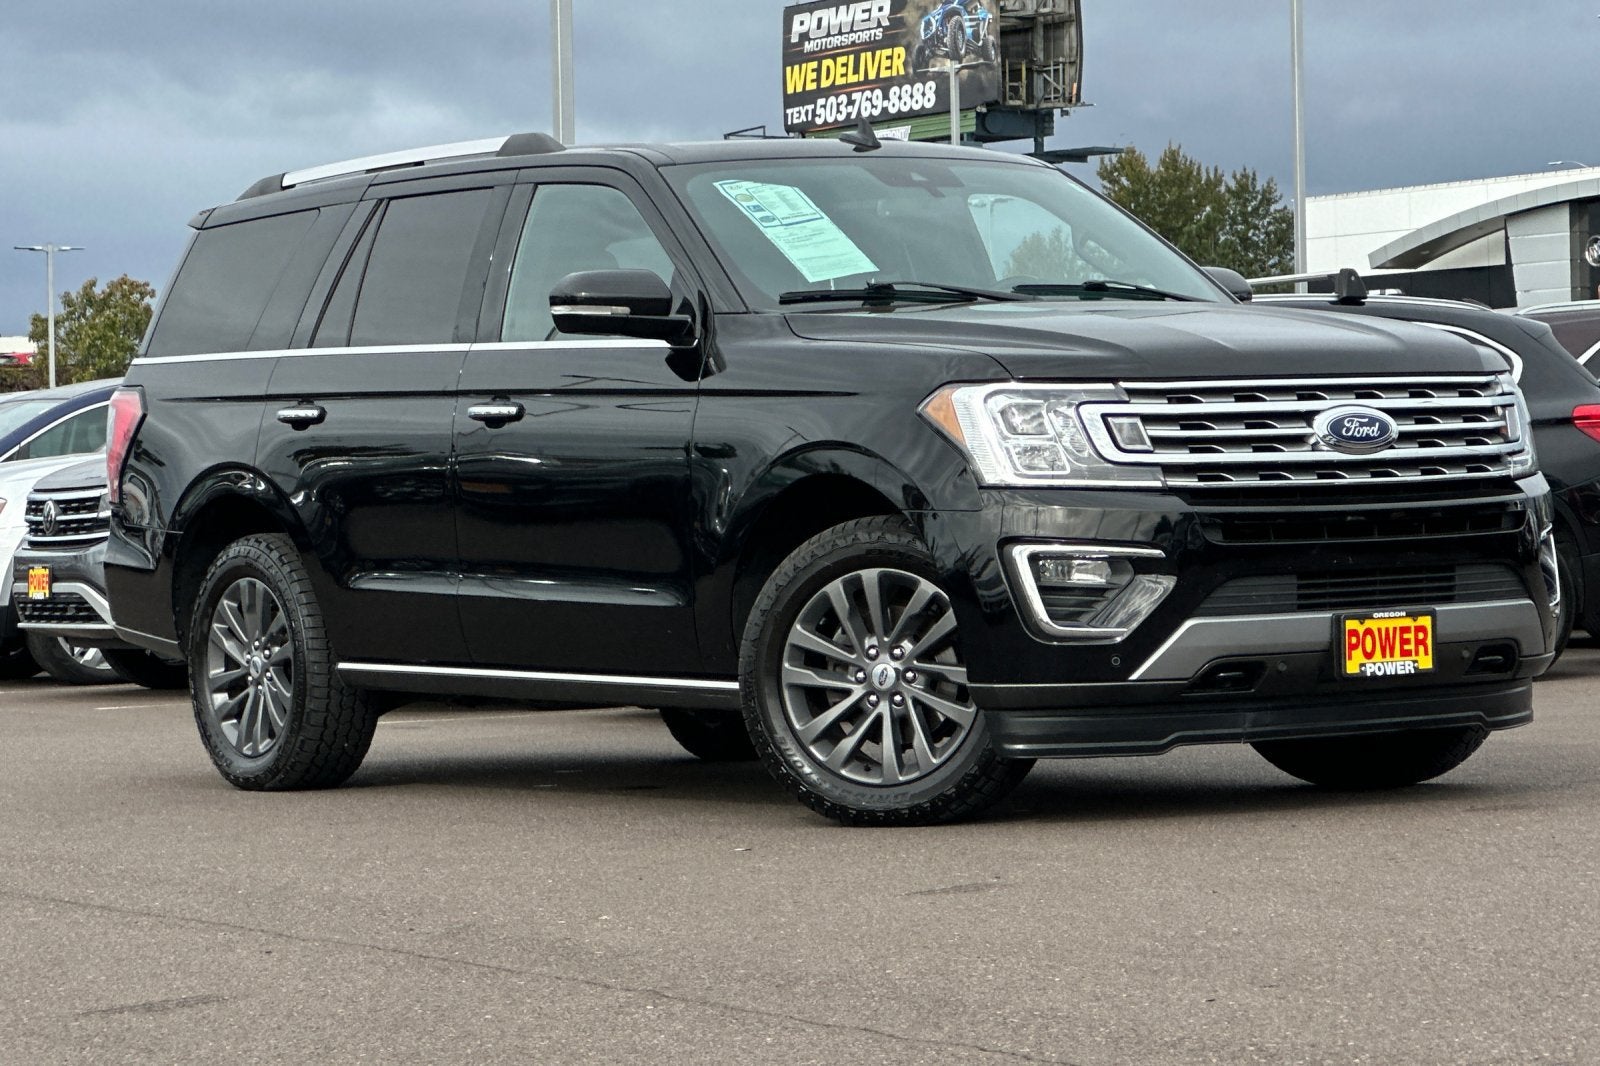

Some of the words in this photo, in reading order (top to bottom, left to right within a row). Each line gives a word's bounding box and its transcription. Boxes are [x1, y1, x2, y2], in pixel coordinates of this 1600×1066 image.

[791, 0, 891, 43] POWER
[804, 28, 882, 53] MOTORSPORTS
[786, 61, 818, 94] WE
[820, 46, 906, 88] DELIVER
[786, 104, 814, 125] TEXT
[815, 81, 936, 125] 503-769-8888
[1341, 417, 1380, 437] Ford
[1347, 624, 1429, 661] POWER
[1366, 661, 1415, 676] POWER
